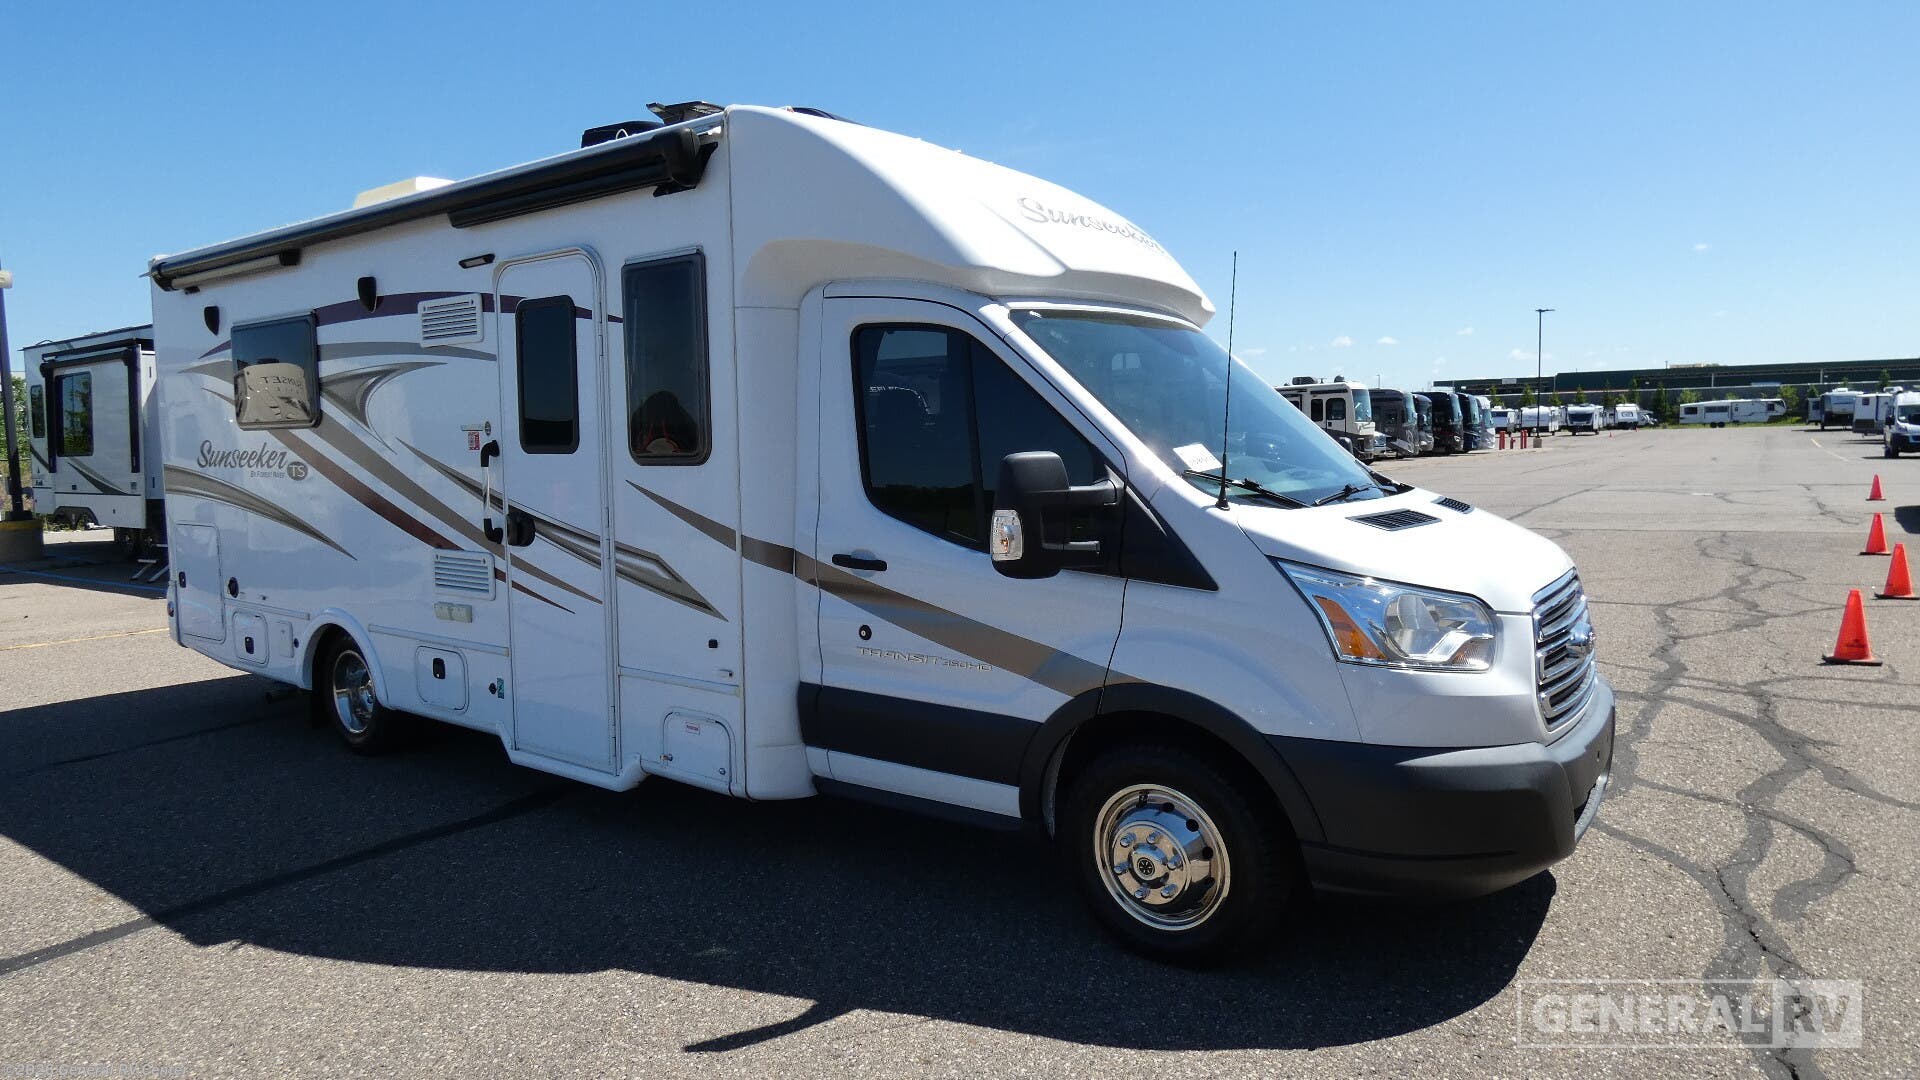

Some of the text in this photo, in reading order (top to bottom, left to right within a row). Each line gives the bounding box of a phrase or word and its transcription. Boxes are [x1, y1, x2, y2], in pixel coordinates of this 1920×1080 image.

[197, 439, 288, 470] Sunseeker
[289, 465, 305, 478] TS
[856, 646, 943, 665] TRANSIT
